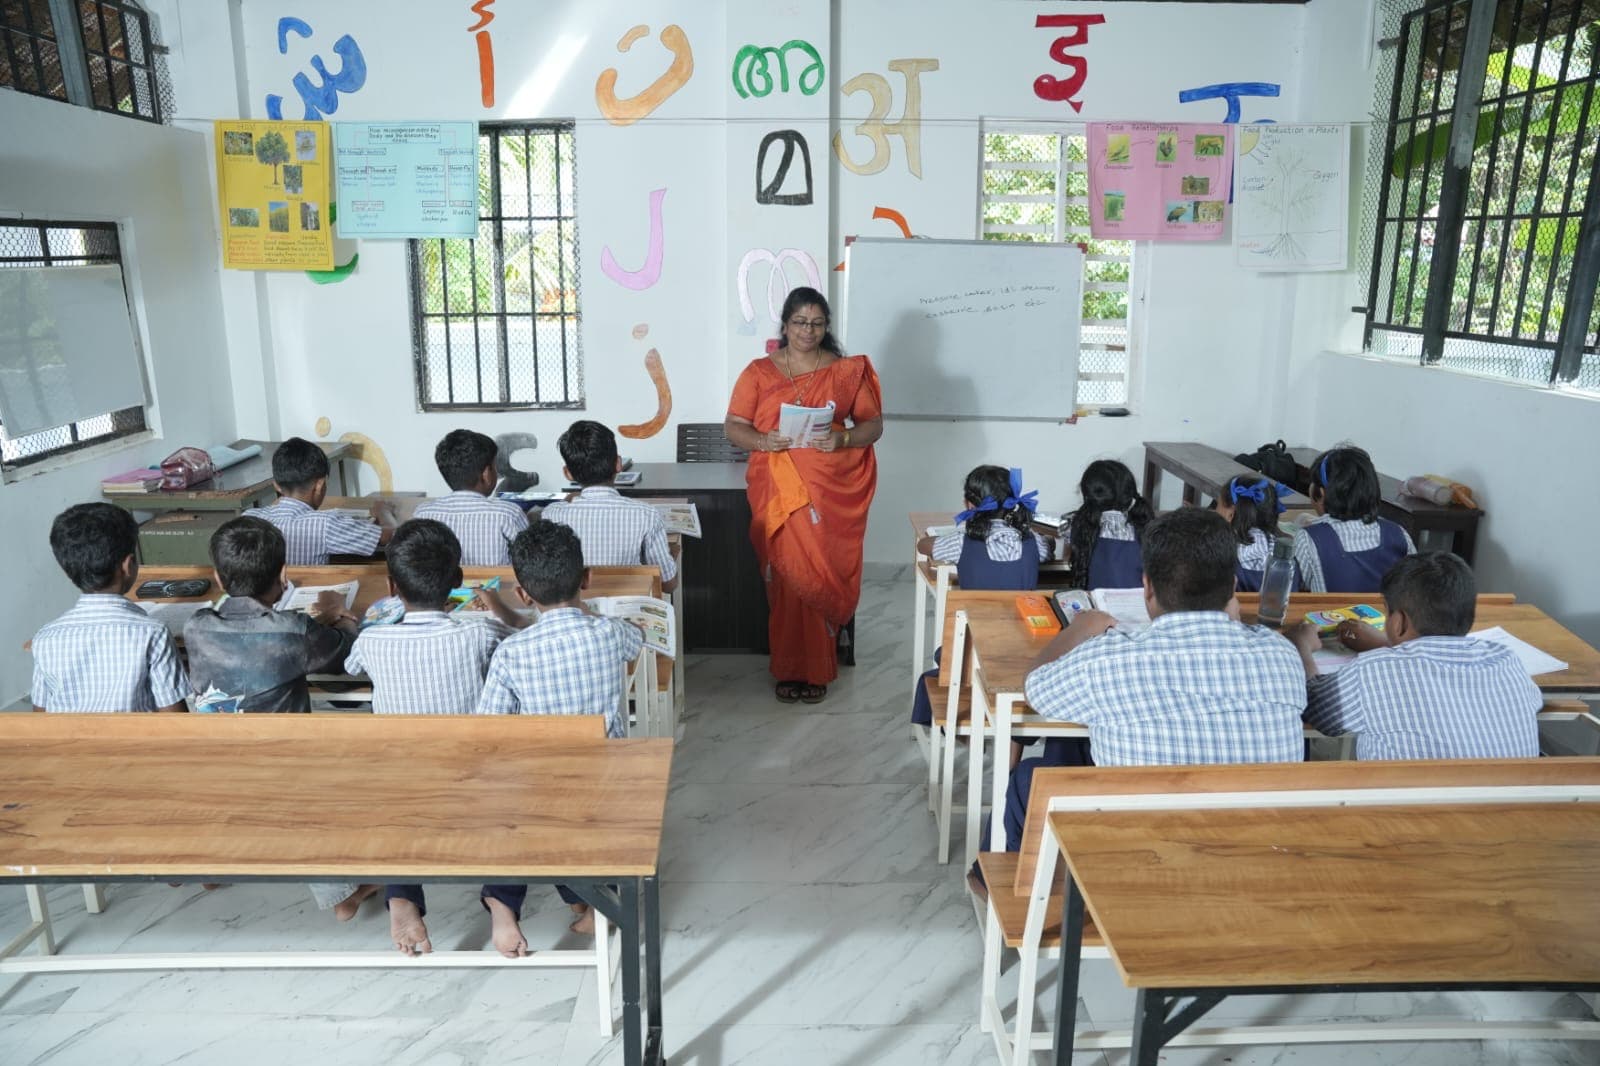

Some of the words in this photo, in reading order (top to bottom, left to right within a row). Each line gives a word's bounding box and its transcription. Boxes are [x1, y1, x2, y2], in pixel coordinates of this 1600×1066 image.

[731, 39, 826, 99] അ
[1032, 13, 1106, 114] इ
[831, 58, 940, 181] अ
